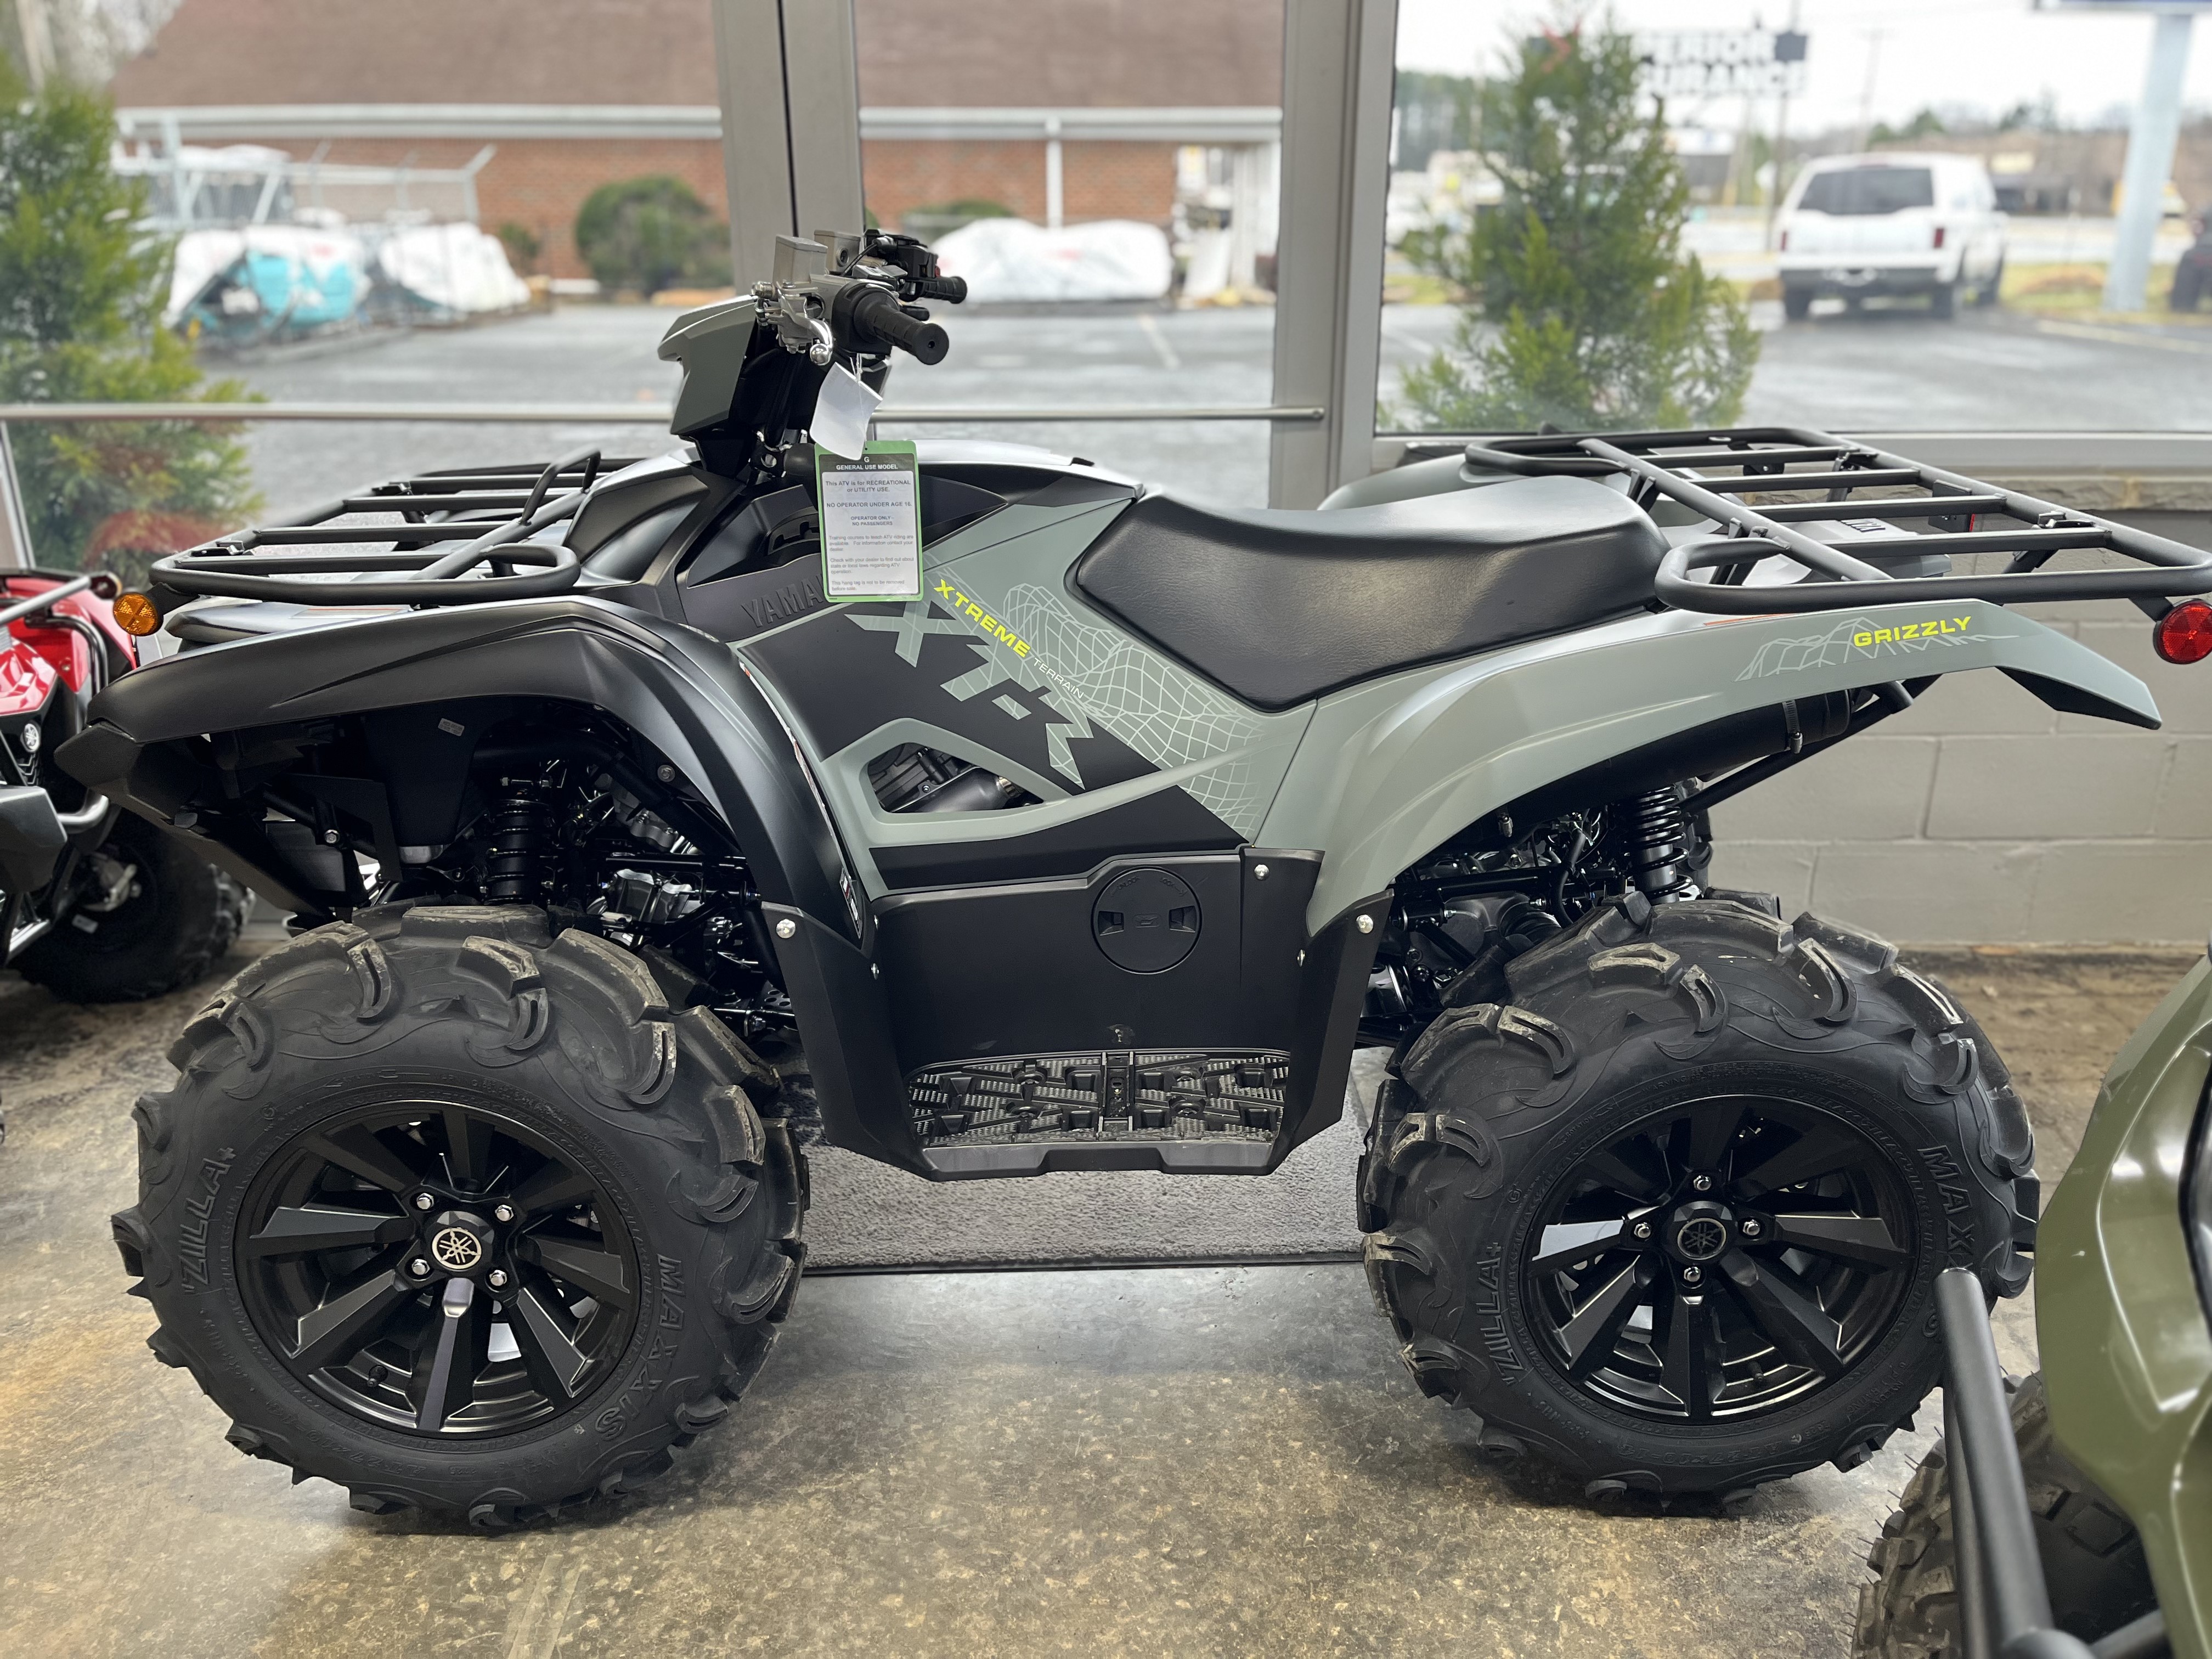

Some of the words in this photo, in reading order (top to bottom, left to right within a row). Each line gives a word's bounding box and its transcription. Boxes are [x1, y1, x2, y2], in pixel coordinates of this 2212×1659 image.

[740, 573, 824, 628] YAMA
[933, 578, 1031, 658] XTREME
[1853, 616, 1972, 647] GRIZZLY
[1033, 657, 1085, 699] TERRAIN
[595, 1253, 686, 1442] MAXXIS
